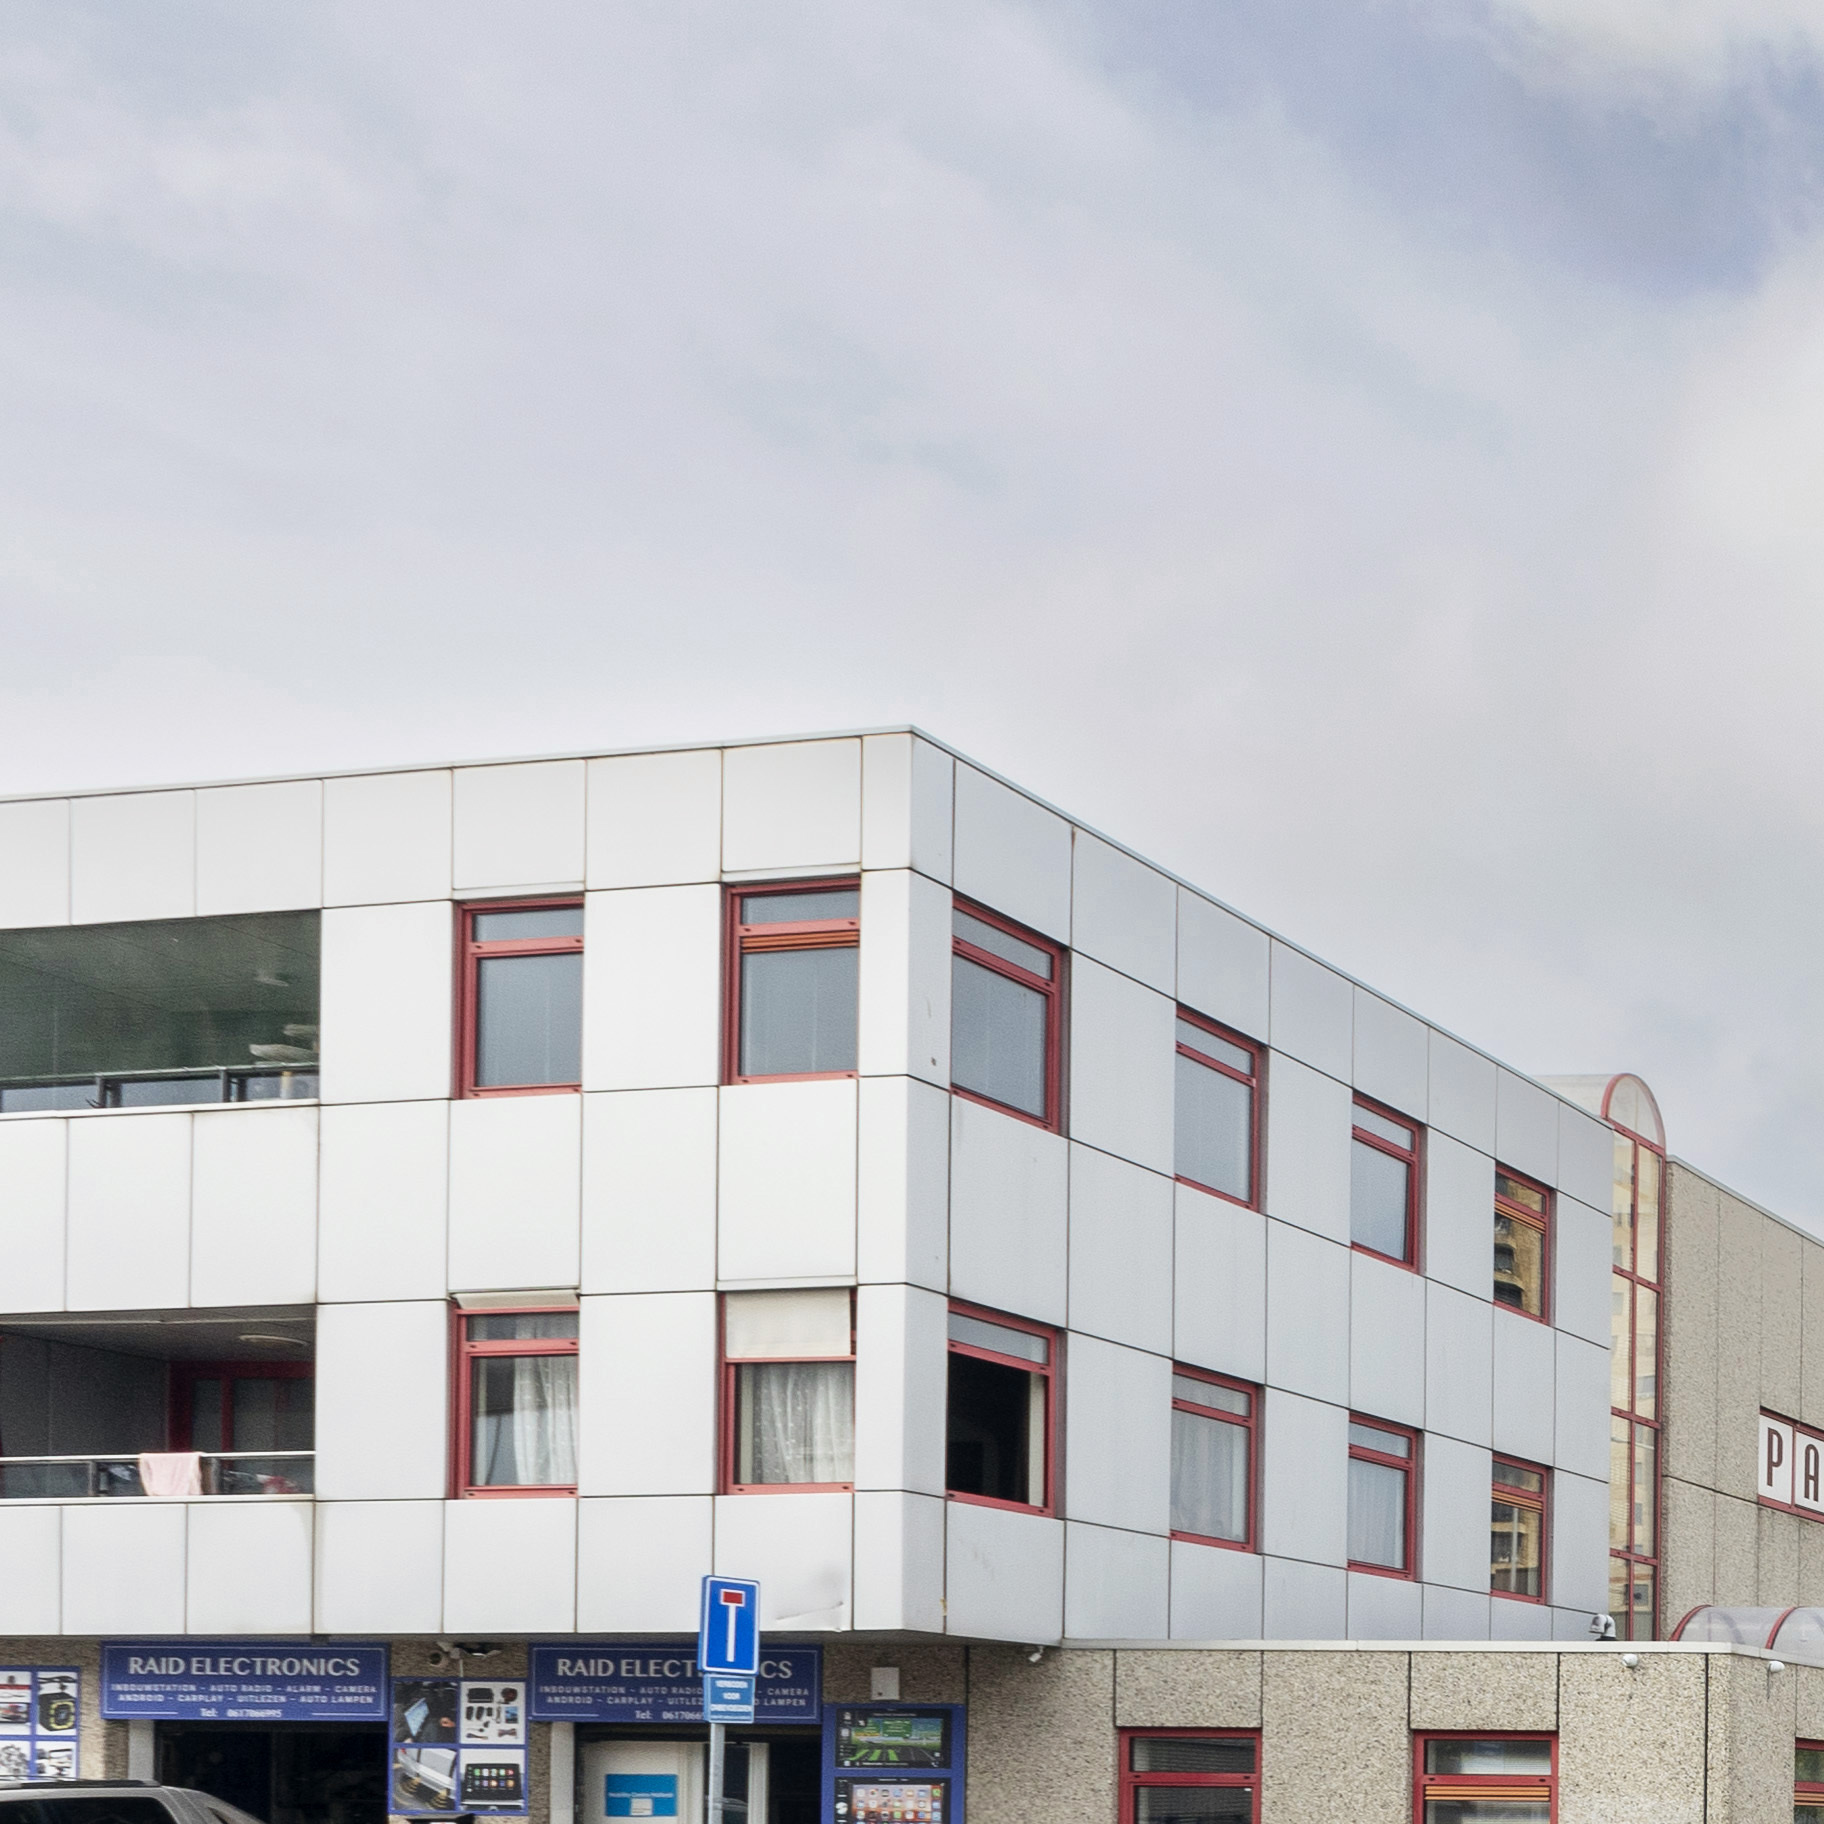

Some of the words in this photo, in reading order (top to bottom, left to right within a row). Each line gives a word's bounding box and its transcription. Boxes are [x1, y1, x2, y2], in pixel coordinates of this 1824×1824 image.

[129, 1656, 185, 1676] RAID
[191, 1656, 360, 1677] ELECTRONICS
[557, 1658, 614, 1677] RAID
[620, 1659, 793, 1679] ELECTCS
[210, 1684, 238, 1693] AUTO
[241, 1684, 272, 1693] RADIO
[286, 1685, 321, 1693] ALARM
[335, 1685, 377, 1694] CAMERA
[540, 1685, 626, 1695] INBOUWSTATION
[640, 1686, 668, 1695] AUTO
[767, 1687, 809, 1696] CAMERA
[118, 1694, 164, 1702] ANDROID
[177, 1694, 223, 1703] CARPLAY
[300, 1696, 328, 1704] AUTO
[331, 1696, 373, 1704] LAMPEN
[547, 1696, 593, 1705] ANDROID
[606, 1696, 653, 1705] CARPLAY
[763, 1698, 806, 1707] LAMPEN
